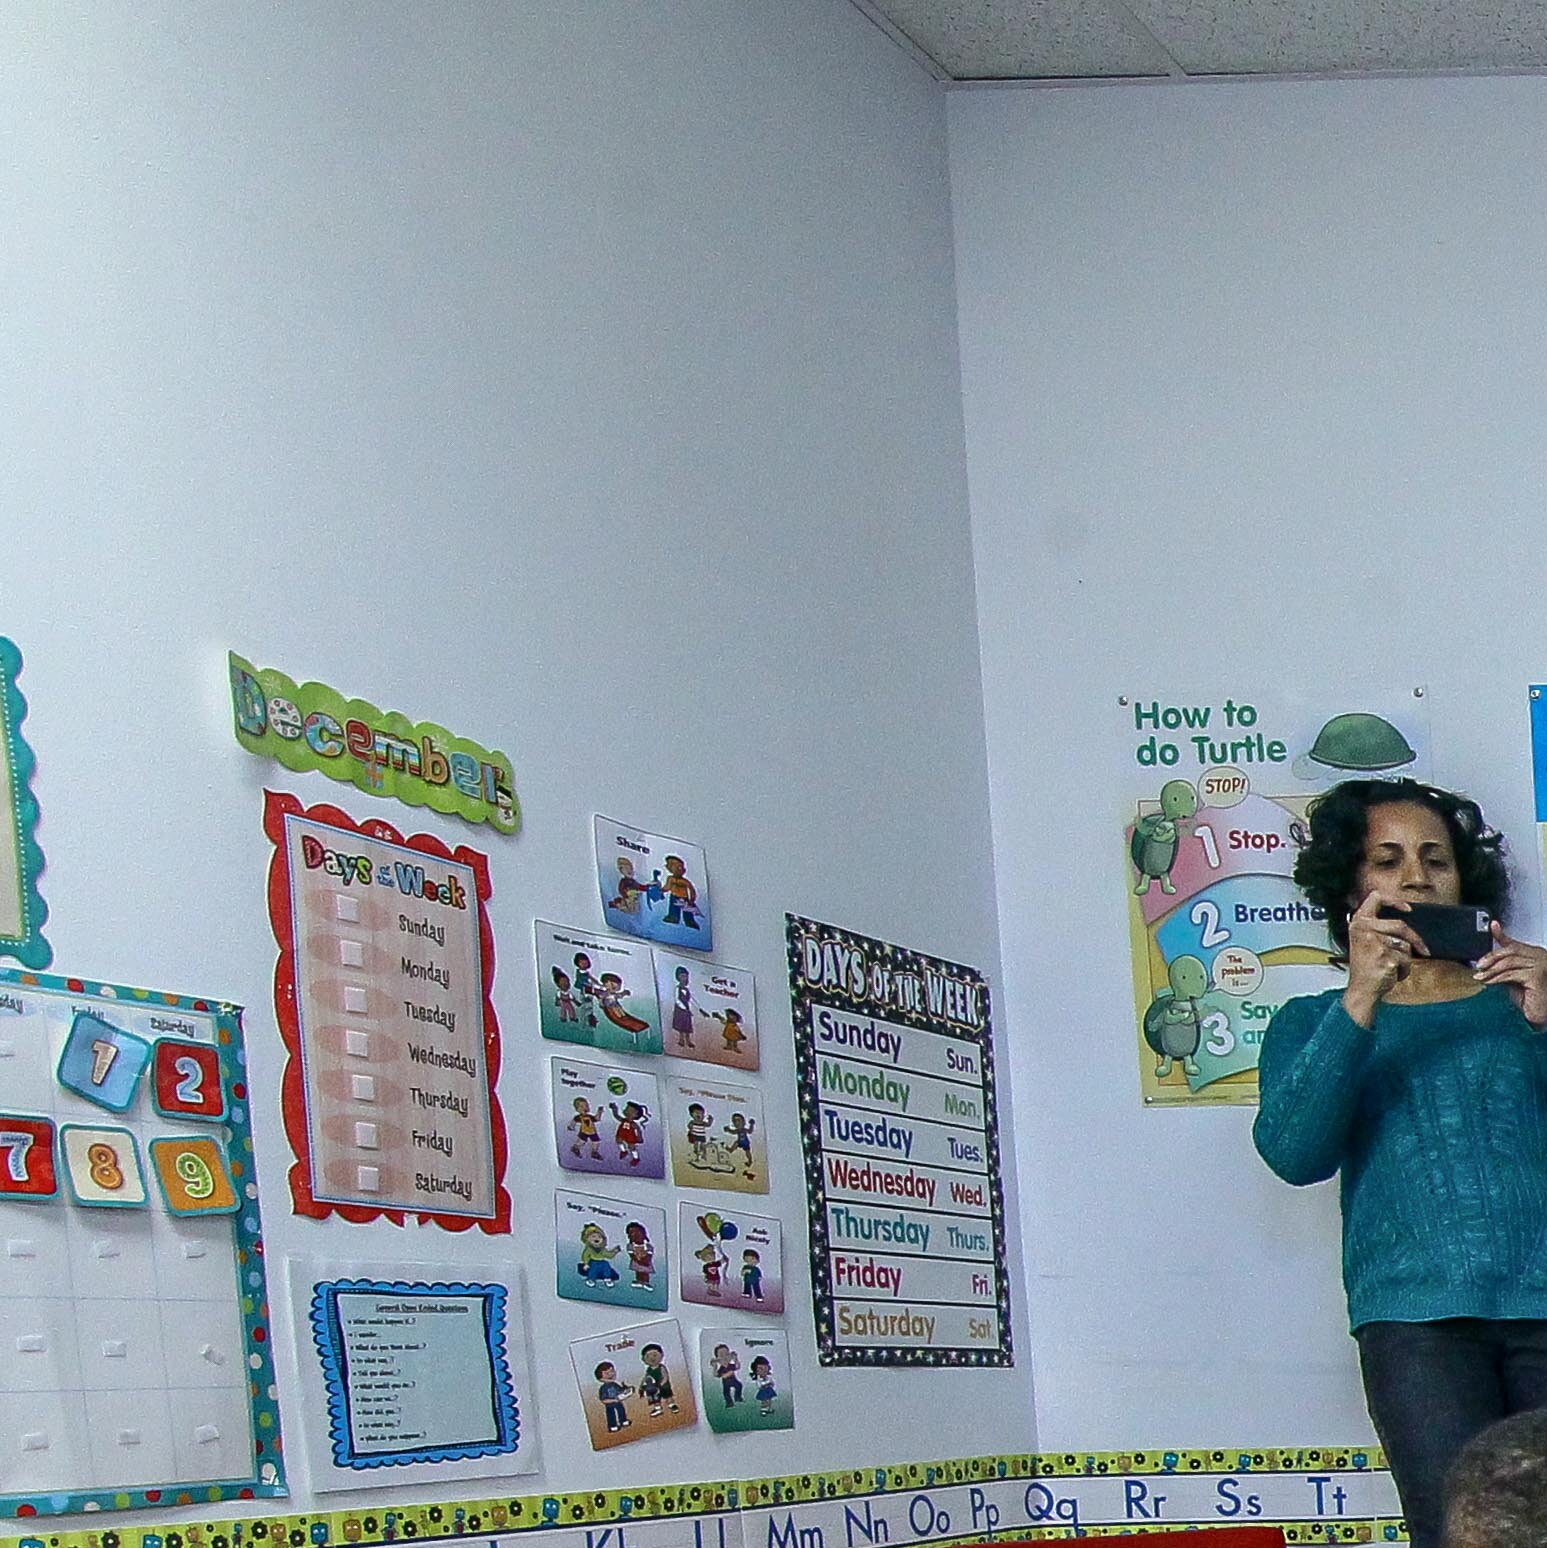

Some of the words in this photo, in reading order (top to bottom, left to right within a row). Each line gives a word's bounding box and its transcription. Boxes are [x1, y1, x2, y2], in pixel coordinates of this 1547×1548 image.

[229, 664, 504, 804] December
[1134, 701, 1210, 731] How
[1223, 699, 1258, 728] to
[1136, 737, 1180, 766] do
[1191, 734, 1287, 764] Turtle
[1205, 776, 1246, 794] STOP!
[615, 835, 650, 855] Share
[1194, 825, 1222, 869] 1
[1228, 829, 1287, 855] Stop.
[302, 835, 373, 886] Days
[394, 861, 467, 910] Week
[399, 914, 446, 947] Sunday
[1190, 901, 1231, 949] 2
[401, 956, 451, 990] Monday
[1221, 965, 1256, 978] problem
[1226, 954, 1243, 965] The
[804, 935, 867, 1000] DAYS
[871, 963, 892, 1004] OF
[923, 966, 984, 1030] WEEK
[404, 1001, 456, 1033] Tuesday
[1202, 1010, 1235, 1057] 3
[91, 1038, 120, 1088] 1
[408, 1042, 477, 1078] Wednesday
[818, 1010, 902, 1064] Sunday
[946, 1048, 978, 1075] Sun.
[174, 1055, 204, 1105] 2
[821, 1060, 911, 1113] Monday
[944, 1092, 980, 1120] Mon.
[409, 1087, 469, 1118] Thursday
[0, 1131, 35, 1182] 7
[412, 1130, 454, 1157] Friday
[824, 1109, 913, 1159] Tuesday
[947, 1136, 984, 1163] Tues.
[87, 1142, 124, 1191] 8
[175, 1151, 216, 1200] 9
[415, 1173, 473, 1202] Saturday
[827, 1157, 936, 1208] Wednesday
[950, 1180, 988, 1208] Wed.
[831, 1206, 930, 1252] Thursday
[946, 1226, 990, 1252] Thurs.
[834, 1256, 903, 1298] Friday
[971, 1273, 993, 1297] Fri.
[604, 1338, 636, 1353] Trade
[838, 1305, 936, 1345] Saturday
[844, 1501, 889, 1548] Nn
[908, 1494, 951, 1538] Oo
[969, 1487, 1001, 1543] Pp
[1023, 1482, 1079, 1537] Qq
[1124, 1479, 1168, 1520] Rr
[1215, 1477, 1263, 1518] Ss
[1306, 1476, 1348, 1517] Tt
